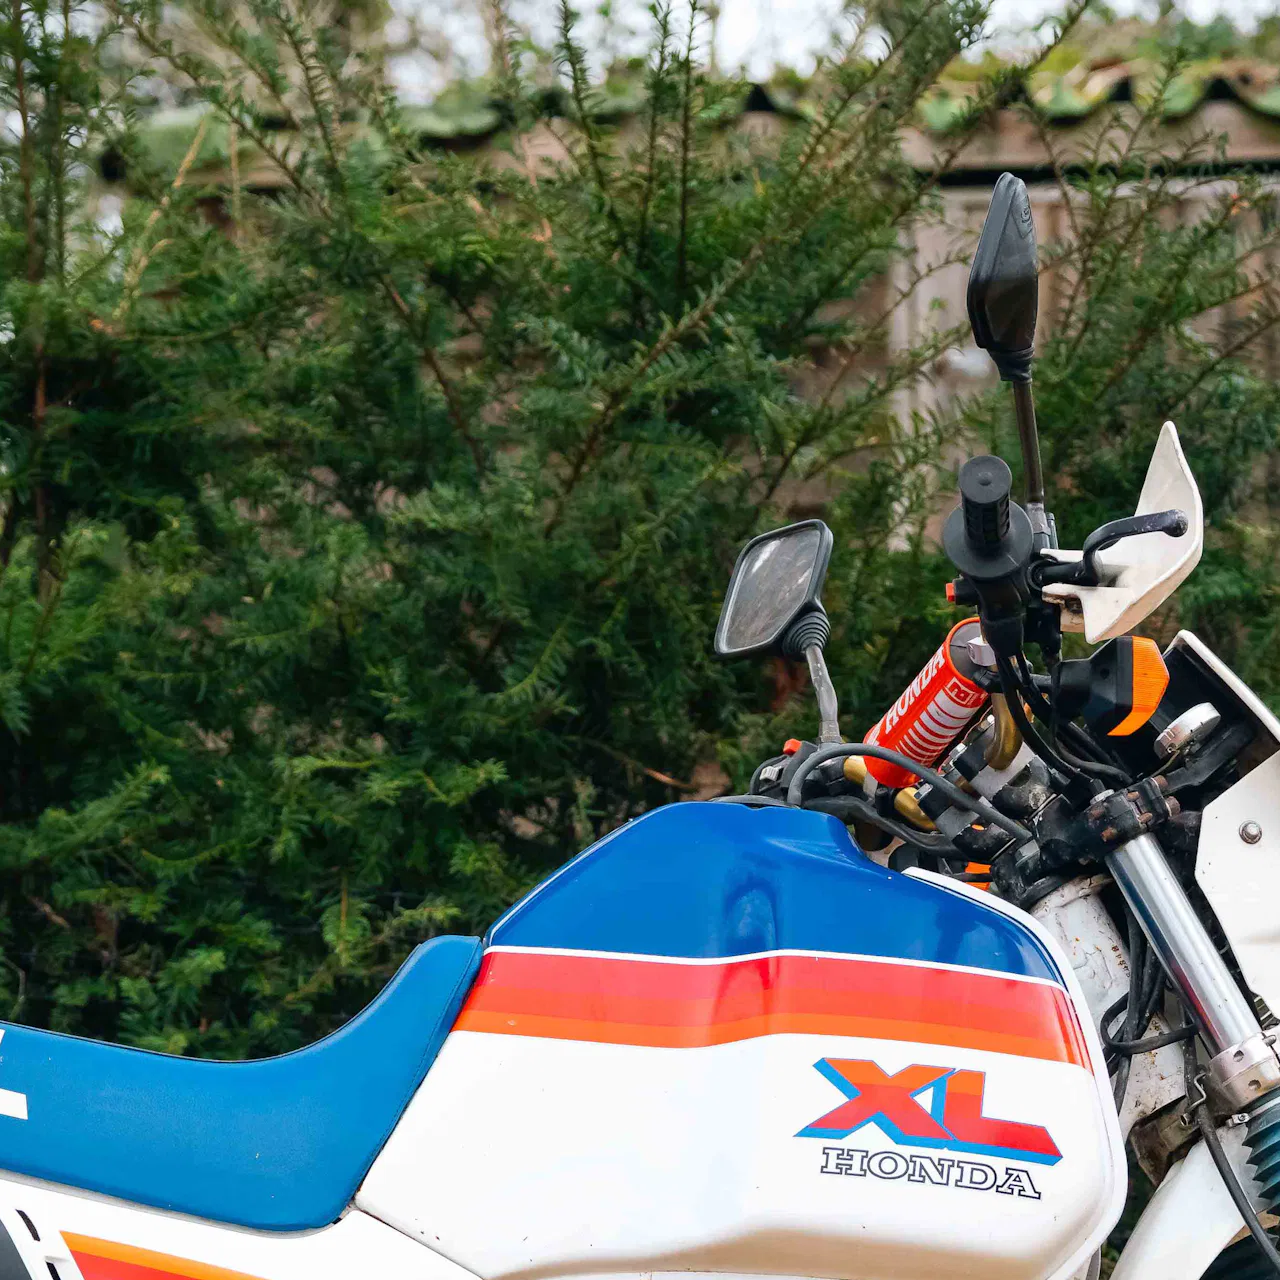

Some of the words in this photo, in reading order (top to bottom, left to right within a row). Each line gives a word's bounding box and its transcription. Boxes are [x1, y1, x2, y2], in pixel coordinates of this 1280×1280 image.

[884, 646, 946, 734] HONDA
[793, 1057, 1063, 1166] XL
[820, 1146, 1041, 1200] HONDA
